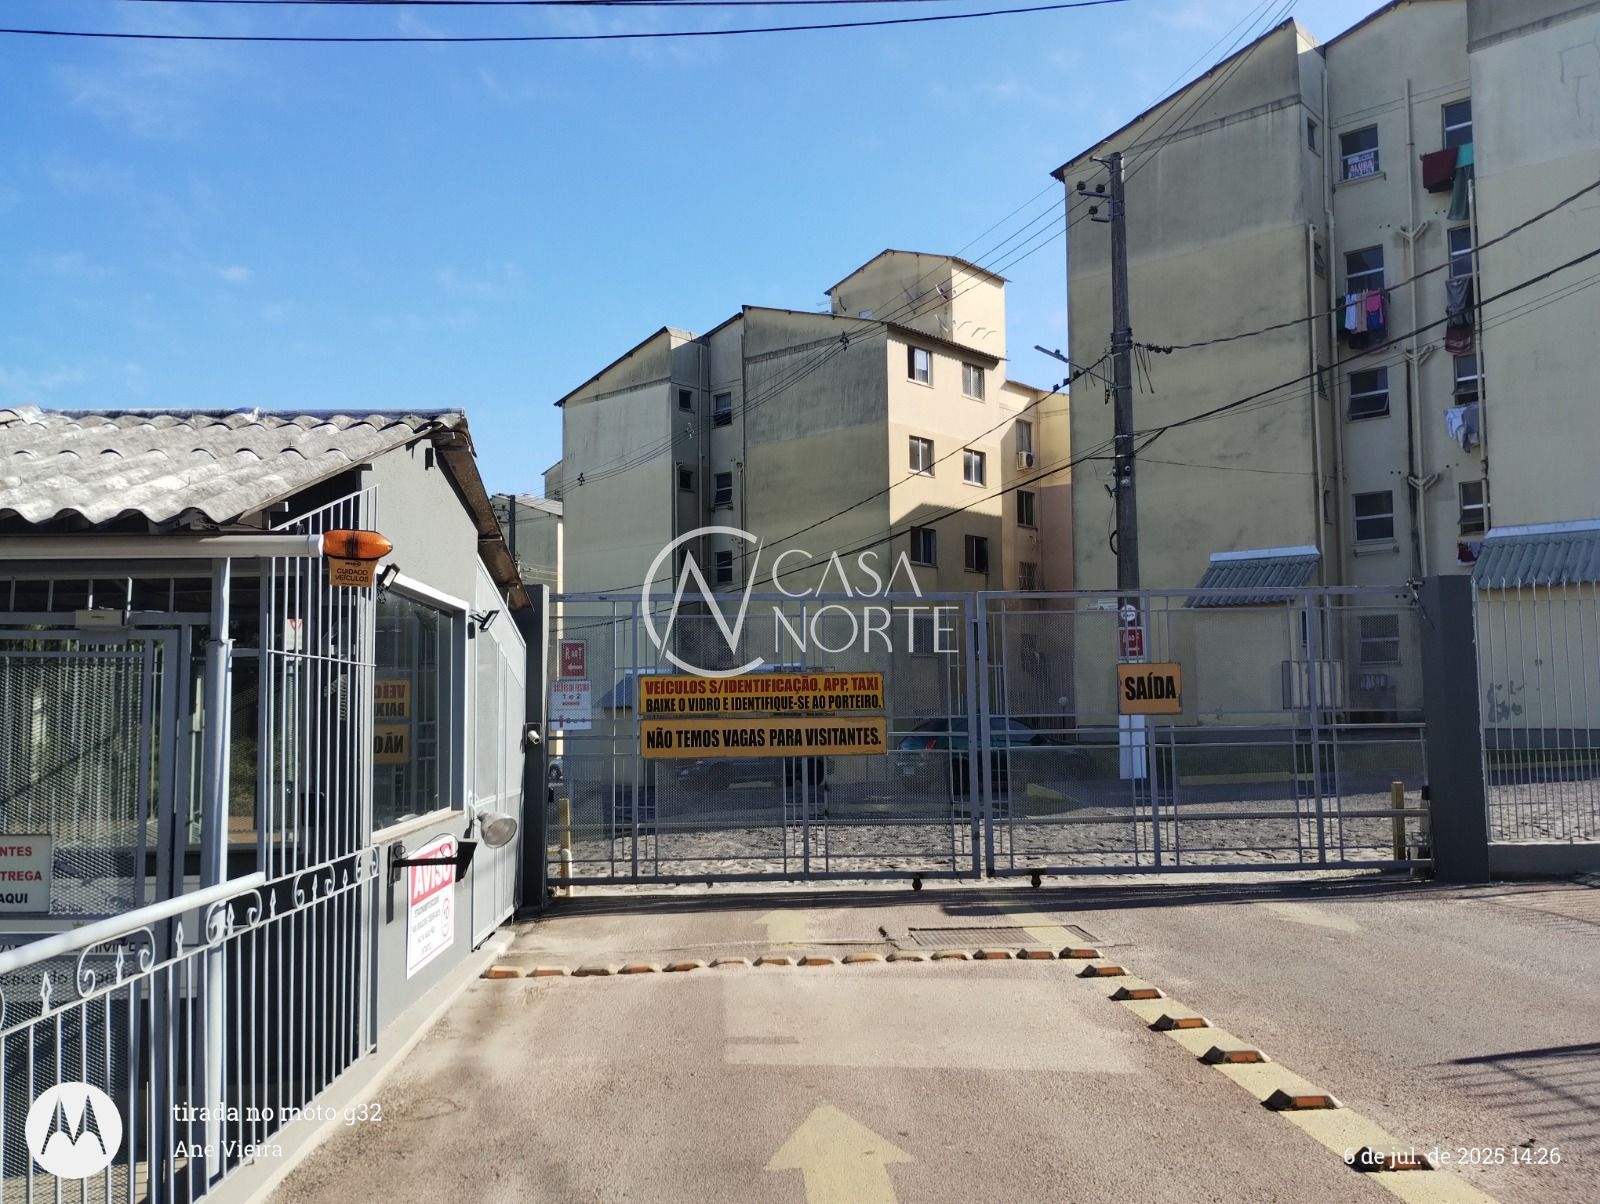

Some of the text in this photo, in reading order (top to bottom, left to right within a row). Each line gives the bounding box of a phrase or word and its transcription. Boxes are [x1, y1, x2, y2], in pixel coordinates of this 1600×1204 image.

[645, 675, 879, 695] VEÍCULOS S/IDENTIFICAÇÃO, APP, TAXI
[1124, 672, 1177, 701] SAÍDA
[646, 694, 882, 713] BAIXE O VIDRO E IDENTIFIQUE-SE AO PORTEIRO.
[646, 727, 882, 749] NÃO TEMOS VAGAS PARA VISITANTES.
[413, 843, 453, 899] AVISO
